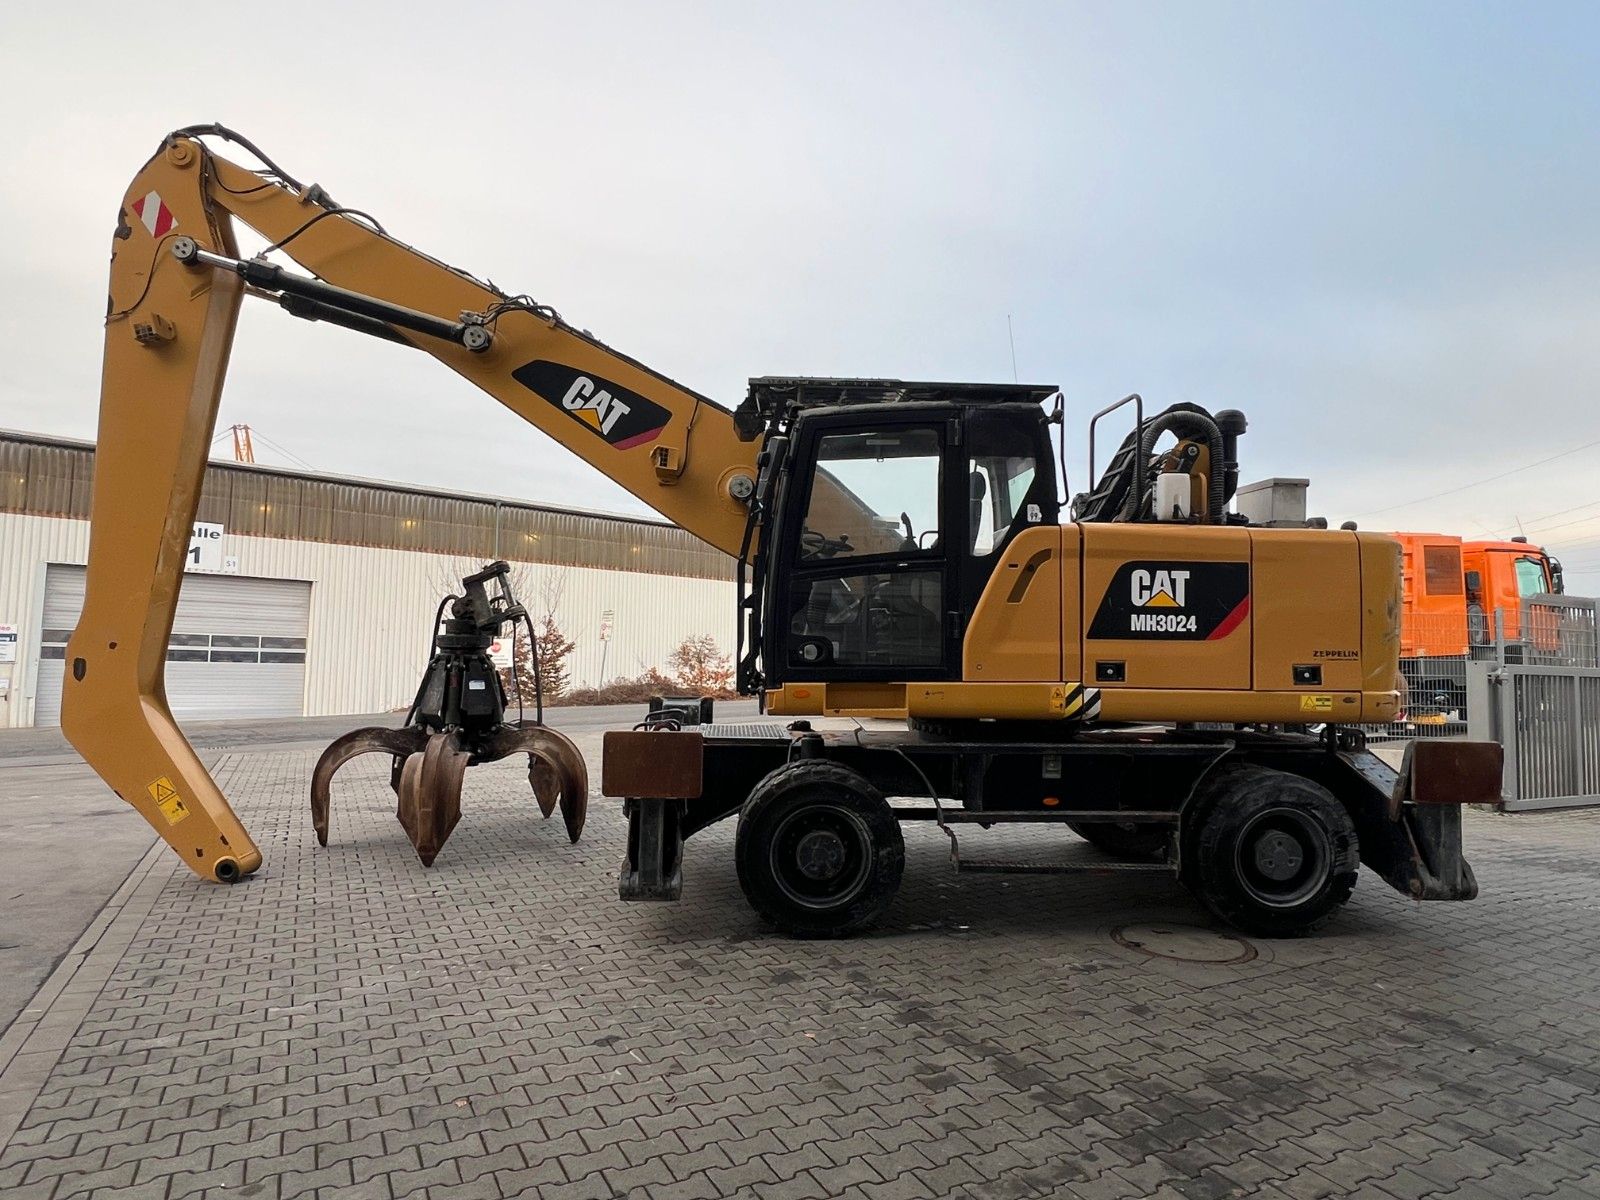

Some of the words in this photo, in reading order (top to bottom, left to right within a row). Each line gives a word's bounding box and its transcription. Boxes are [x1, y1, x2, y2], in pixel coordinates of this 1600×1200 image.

[562, 376, 631, 436] CAT
[189, 546, 201, 564] 1
[1131, 569, 1190, 607] CAT
[1130, 614, 1197, 632] MH3024
[1312, 650, 1359, 658] ZEPPELIN
